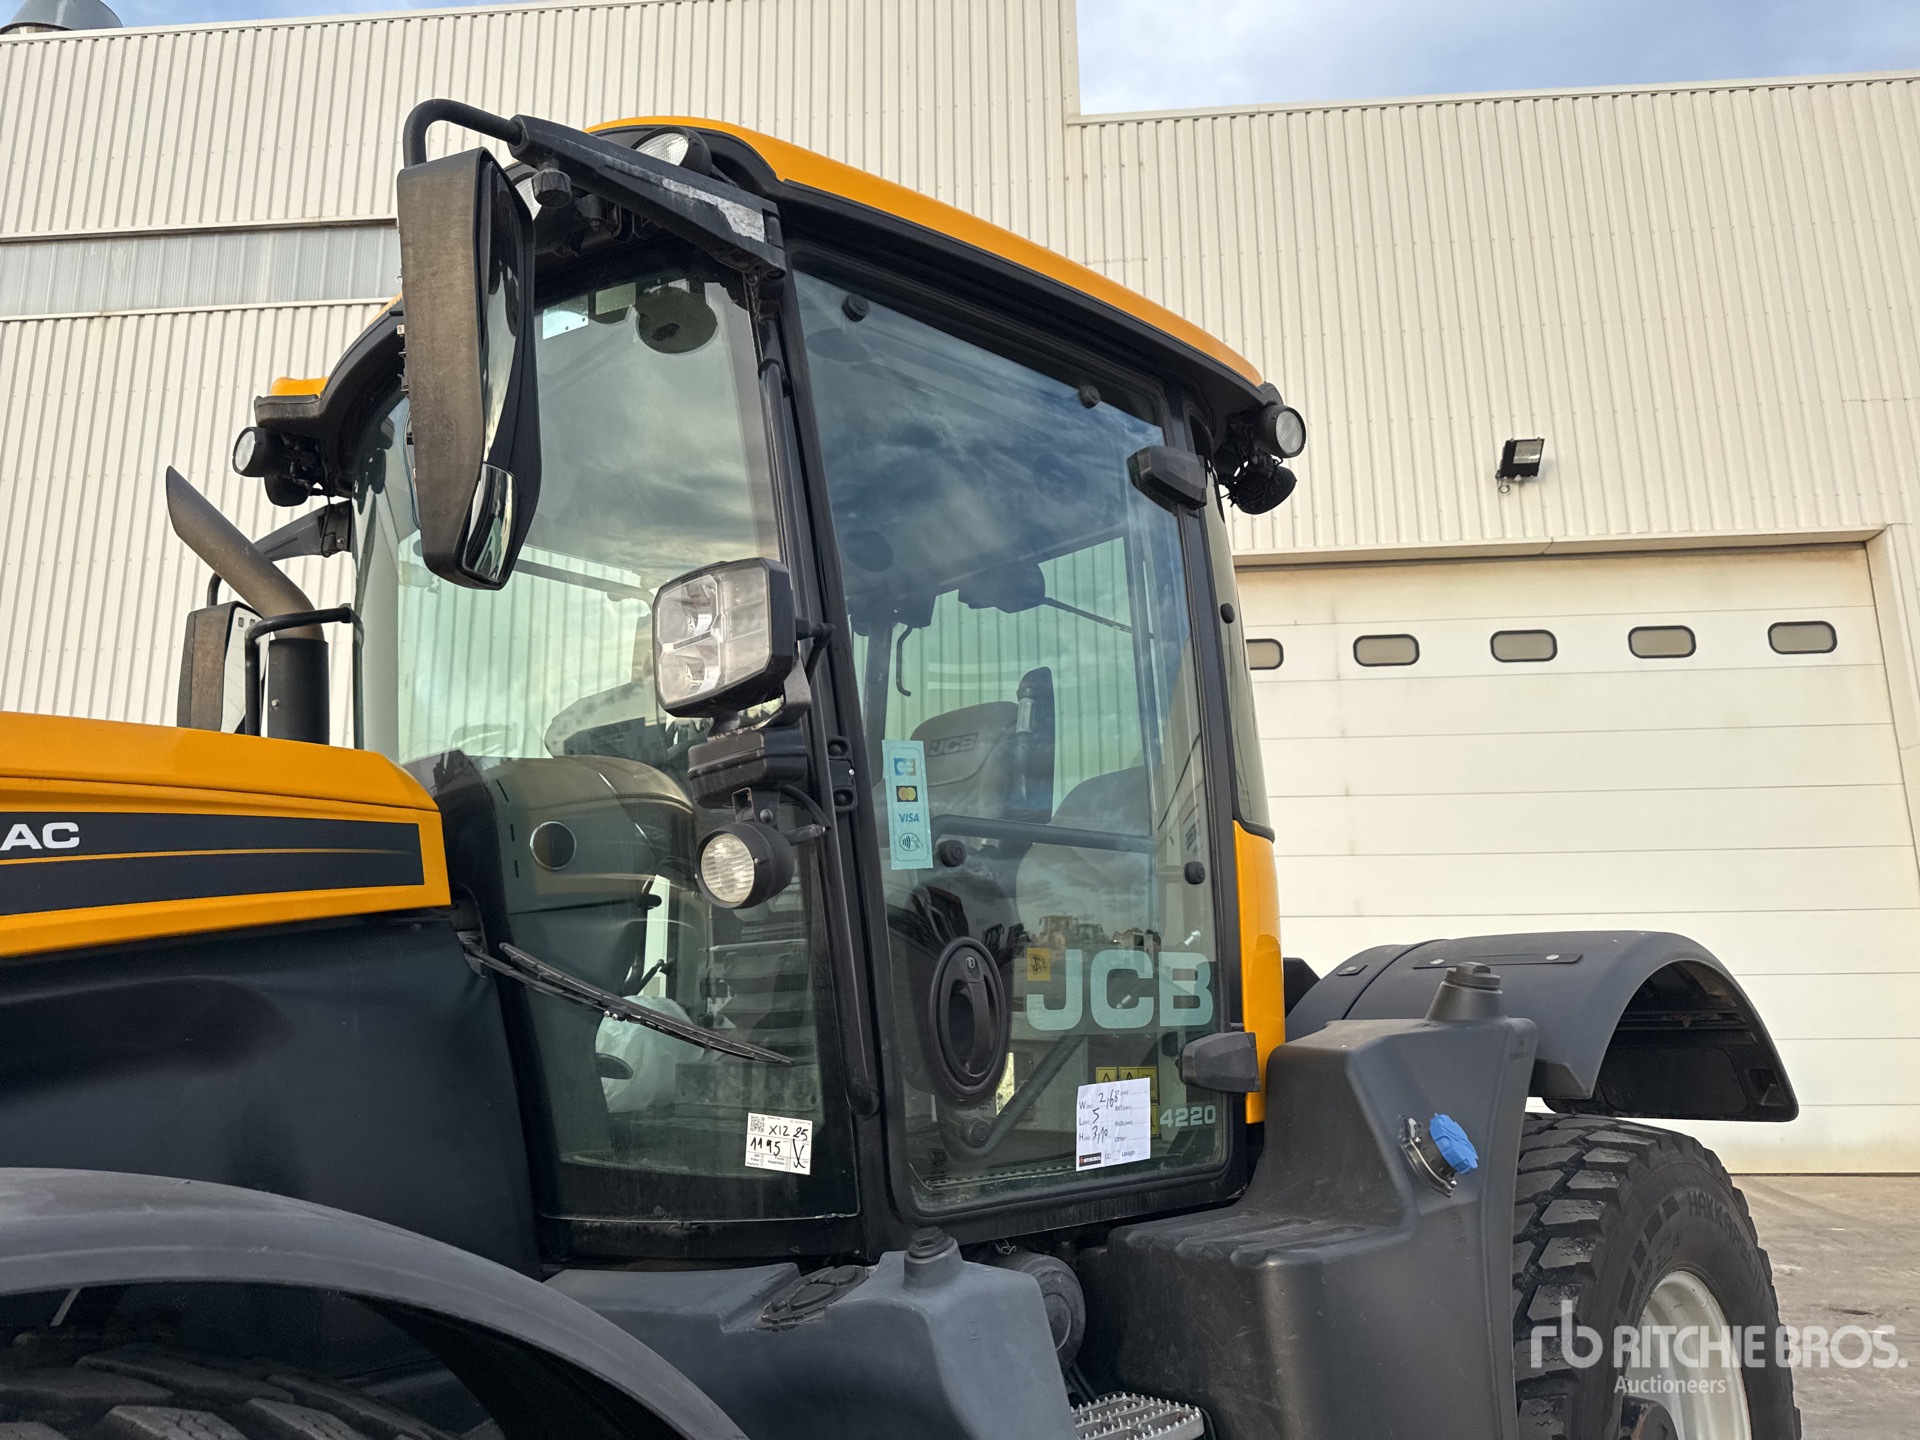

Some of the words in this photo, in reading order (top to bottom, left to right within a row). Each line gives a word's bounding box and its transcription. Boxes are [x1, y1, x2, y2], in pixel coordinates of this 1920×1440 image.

[929, 733, 977, 756] JCB
[898, 813, 920, 823] VISA
[0, 822, 80, 850] AC
[1027, 949, 1214, 1031] JCB
[1092, 1107, 1100, 1124] 5
[1160, 1105, 1216, 1128] 4220
